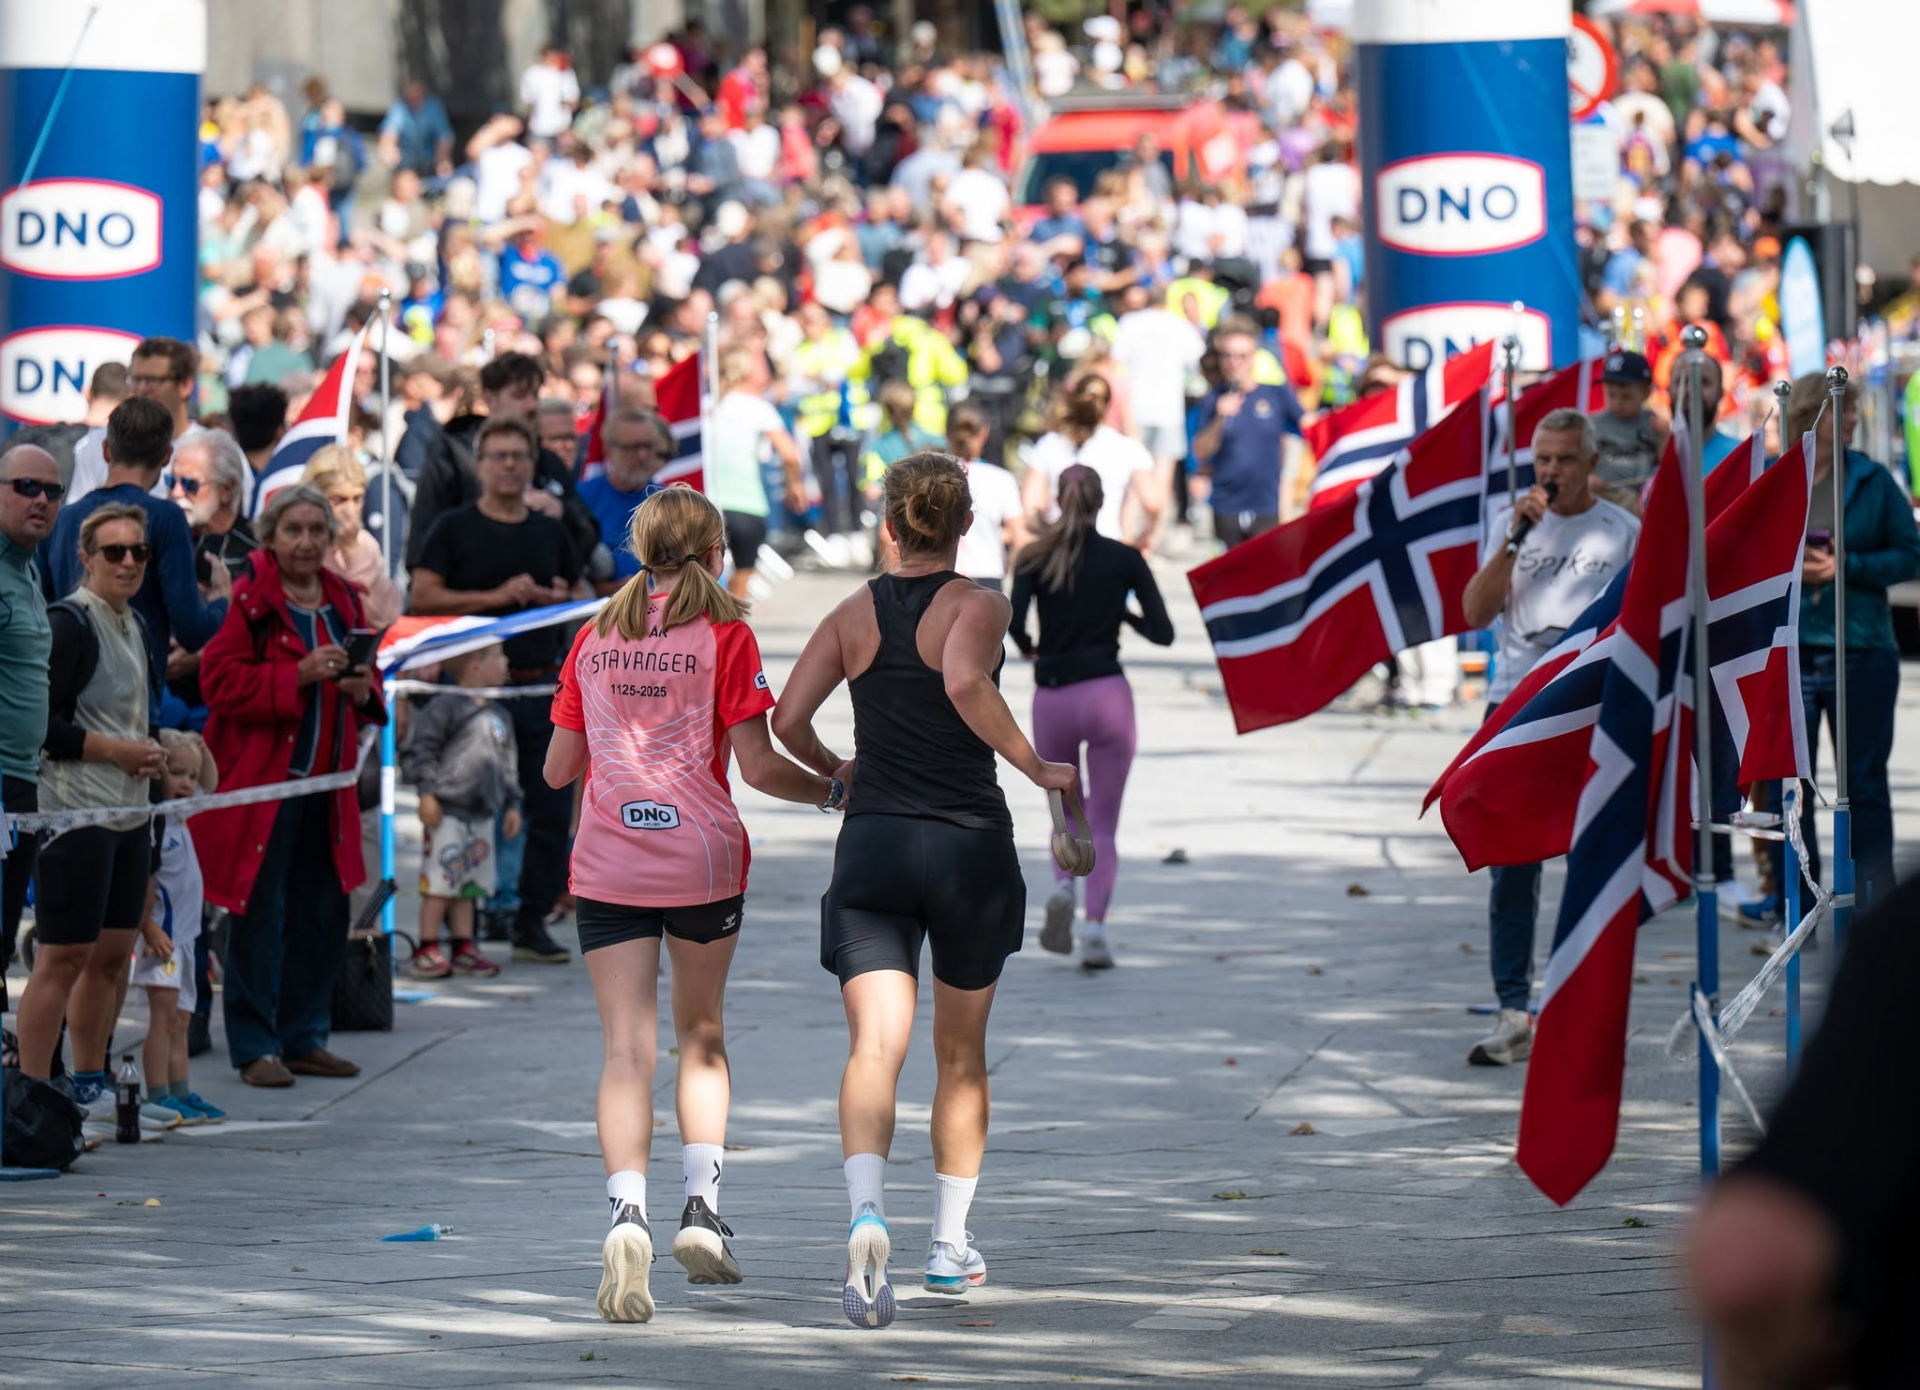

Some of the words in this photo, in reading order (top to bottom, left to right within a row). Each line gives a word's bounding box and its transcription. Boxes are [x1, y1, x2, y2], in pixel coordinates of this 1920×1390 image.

[1397, 184, 1518, 224] DNO
[17, 211, 135, 248] DNO
[15, 358, 86, 394] DN
[591, 649, 697, 675] STAVANGER
[610, 683, 667, 698] 1125-2025
[629, 807, 672, 823] DNO
